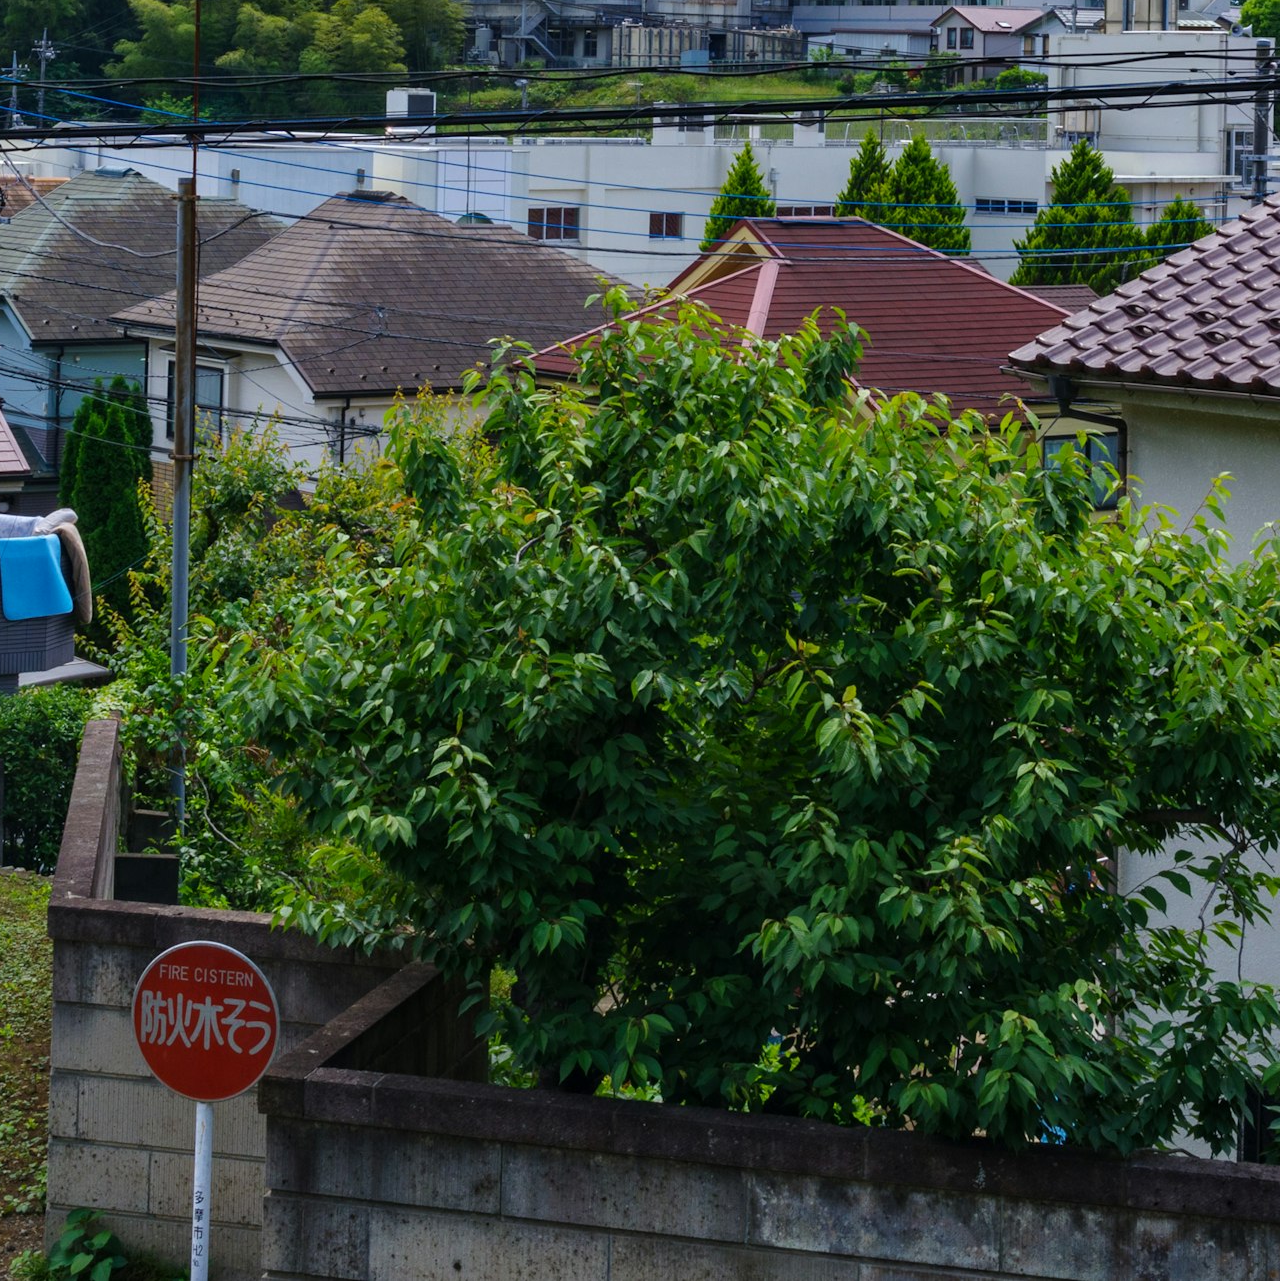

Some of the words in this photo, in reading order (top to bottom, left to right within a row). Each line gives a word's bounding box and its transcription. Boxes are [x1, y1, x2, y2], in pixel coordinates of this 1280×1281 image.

[159, 963, 189, 981] FIRE
[194, 967, 254, 987] CISTERN
[141, 990, 271, 1055] 防火水そう
[194, 1190, 204, 1240] 多摩市
